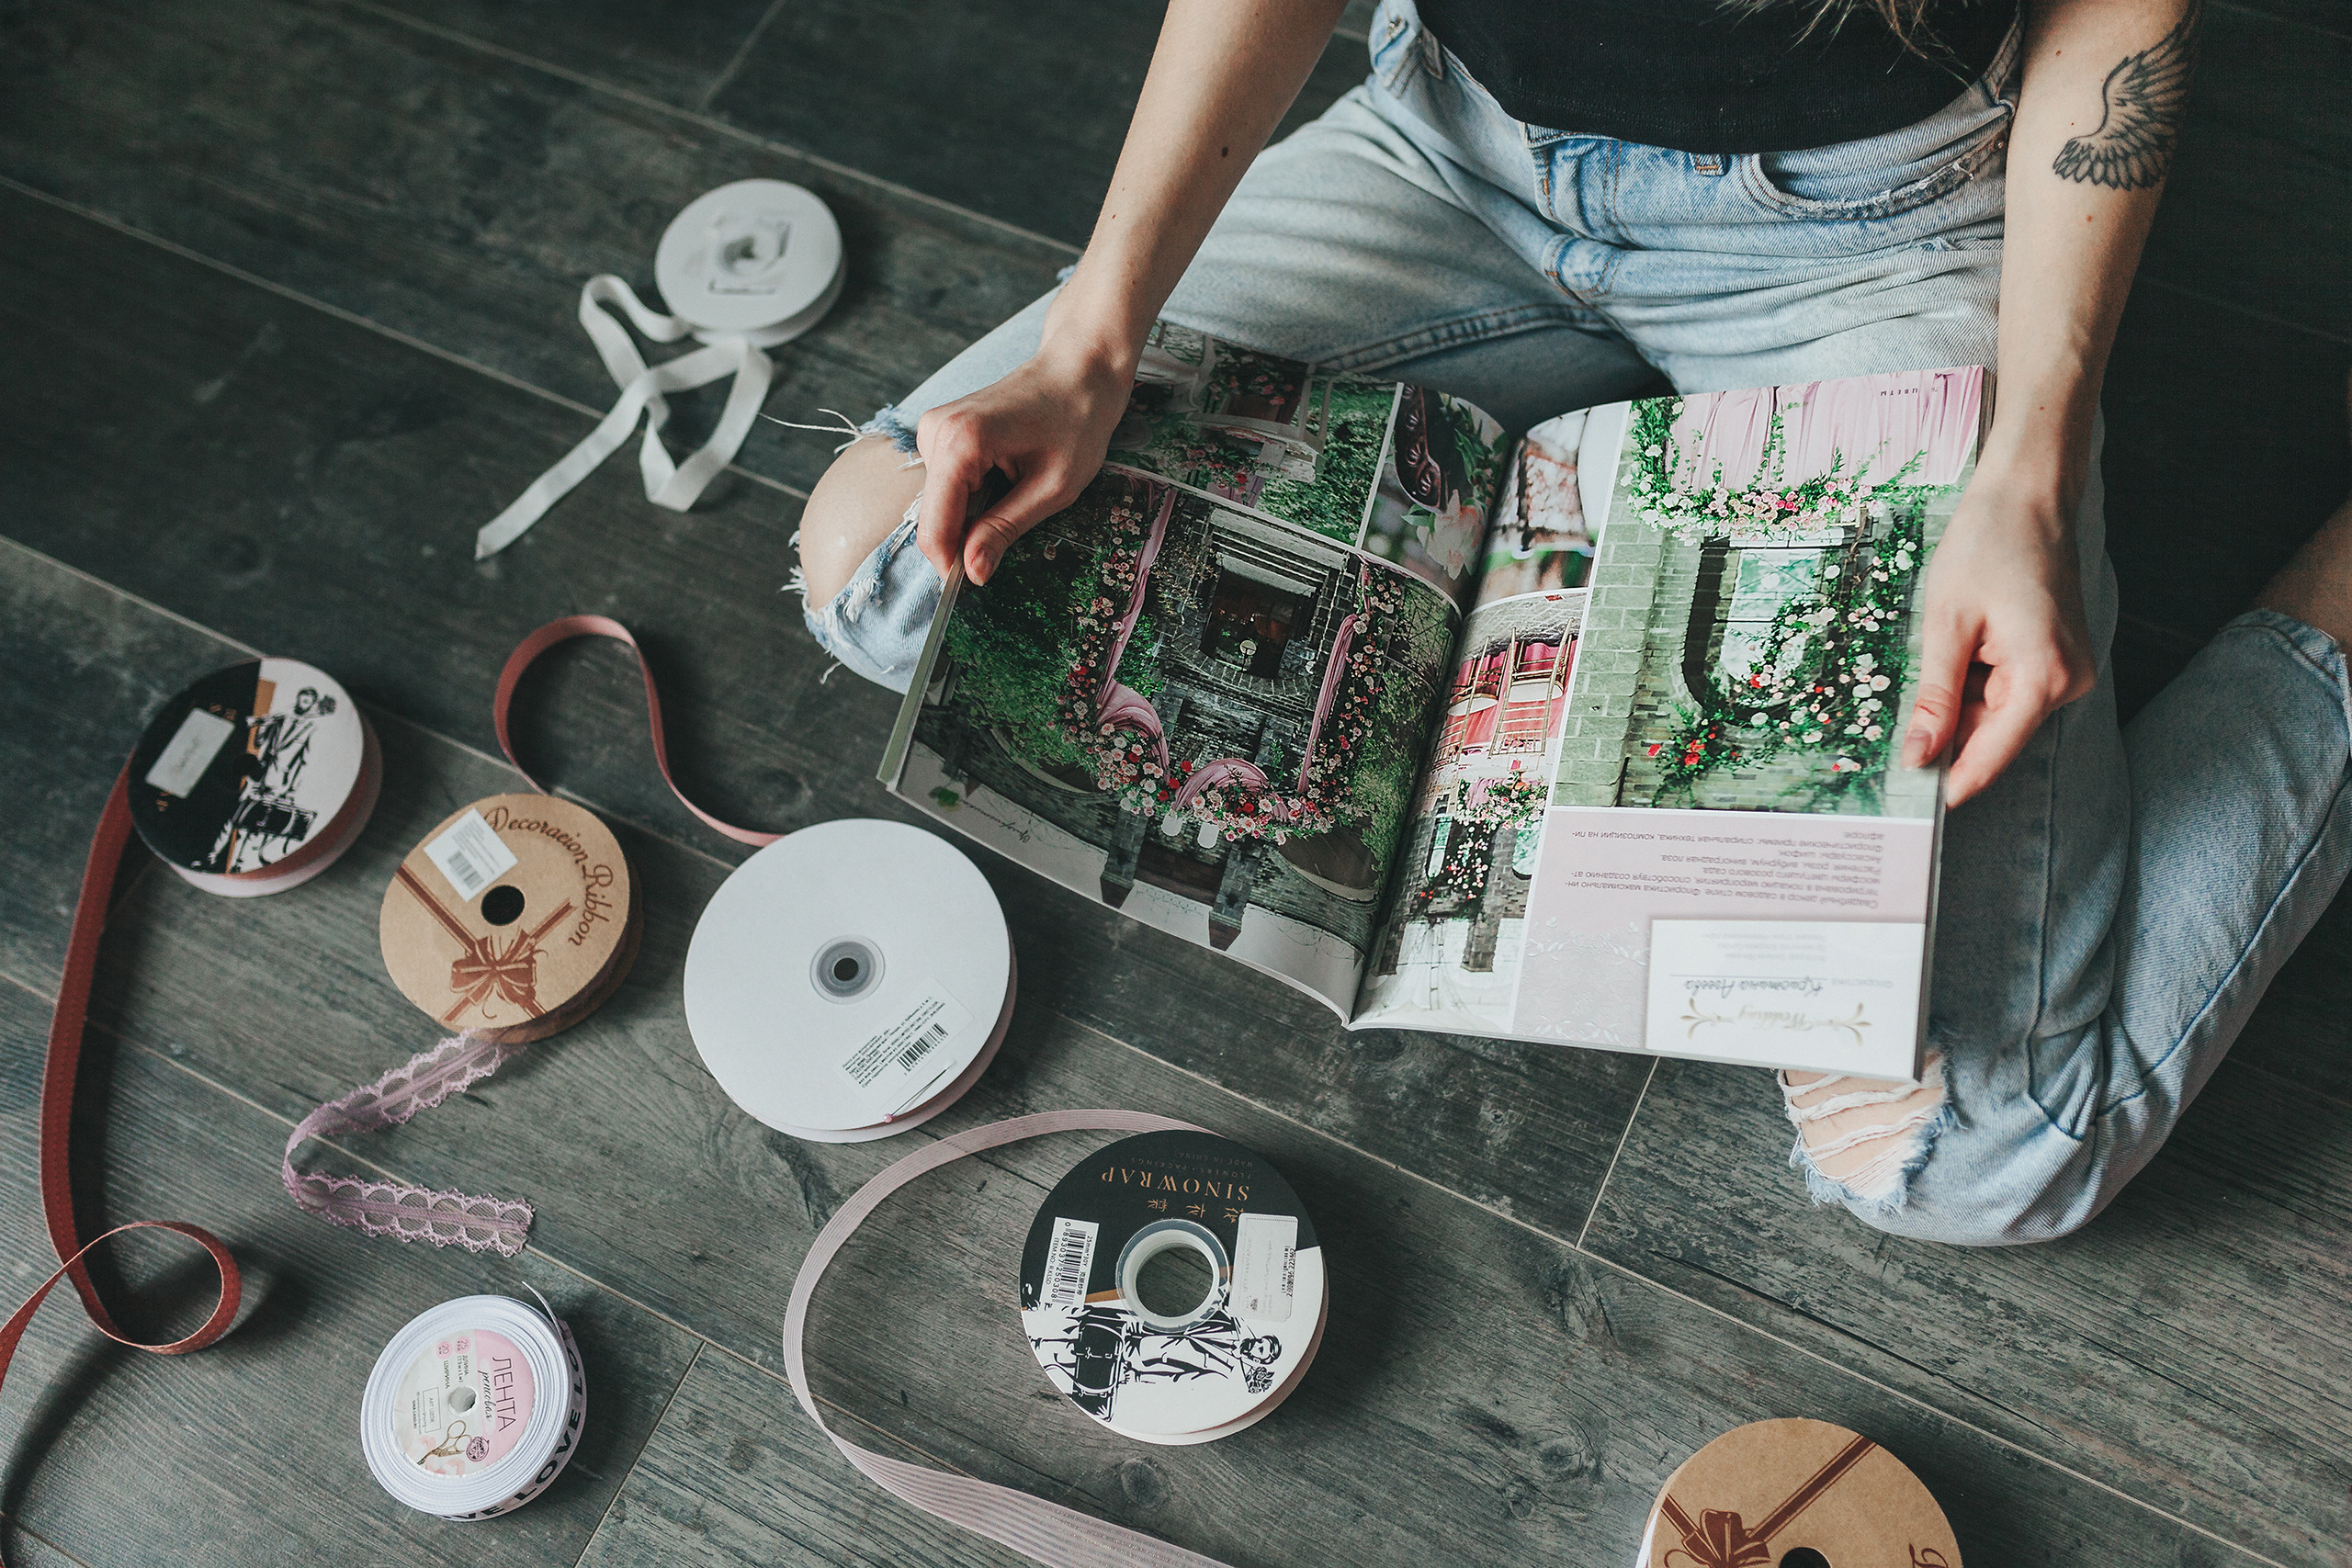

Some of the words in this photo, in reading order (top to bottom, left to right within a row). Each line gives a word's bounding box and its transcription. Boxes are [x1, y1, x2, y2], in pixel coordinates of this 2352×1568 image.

[1880, 388, 1918, 397] ЦВЕТЫ
[1600, 830, 1656, 840] композиции
[1658, 833, 1695, 843] техника,
[1698, 836, 1754, 846] спиральная
[1660, 855, 1684, 863] лоза.
[1686, 855, 1747, 866] виноградная
[1571, 871, 1584, 879] ат-
[1586, 871, 1631, 881] созданию
[1633, 873, 1691, 884] способствуя
[1729, 869, 1774, 878] розового
[1581, 881, 1642, 892] максимально
[1644, 885, 1701, 897] Флористика
[1761, 881, 1804, 891] локацию
[1815, 885, 1879, 897] тегрирована
[1735, 891, 1778, 900] садовом
[1787, 894, 1818, 904] декор
[568, 864, 614, 946] Ribbon
[1820, 897, 1879, 909] Свадебный
[1131, 1157, 1187, 1171] PACKINGS
[1102, 1167, 1250, 1201] SINOWRAP
[1057, 1231, 1070, 1263] 893037
[1050, 1267, 1064, 1300] 250308
[441, 1343, 450, 1355] 20
[460, 1338, 469, 1350] 25
[443, 1359, 451, 1390] ШИРИНА
[477, 1370, 497, 1423] репсовая
[492, 1356, 516, 1433] ЛЕНТА
[513, 1408, 582, 1501] LOVE
